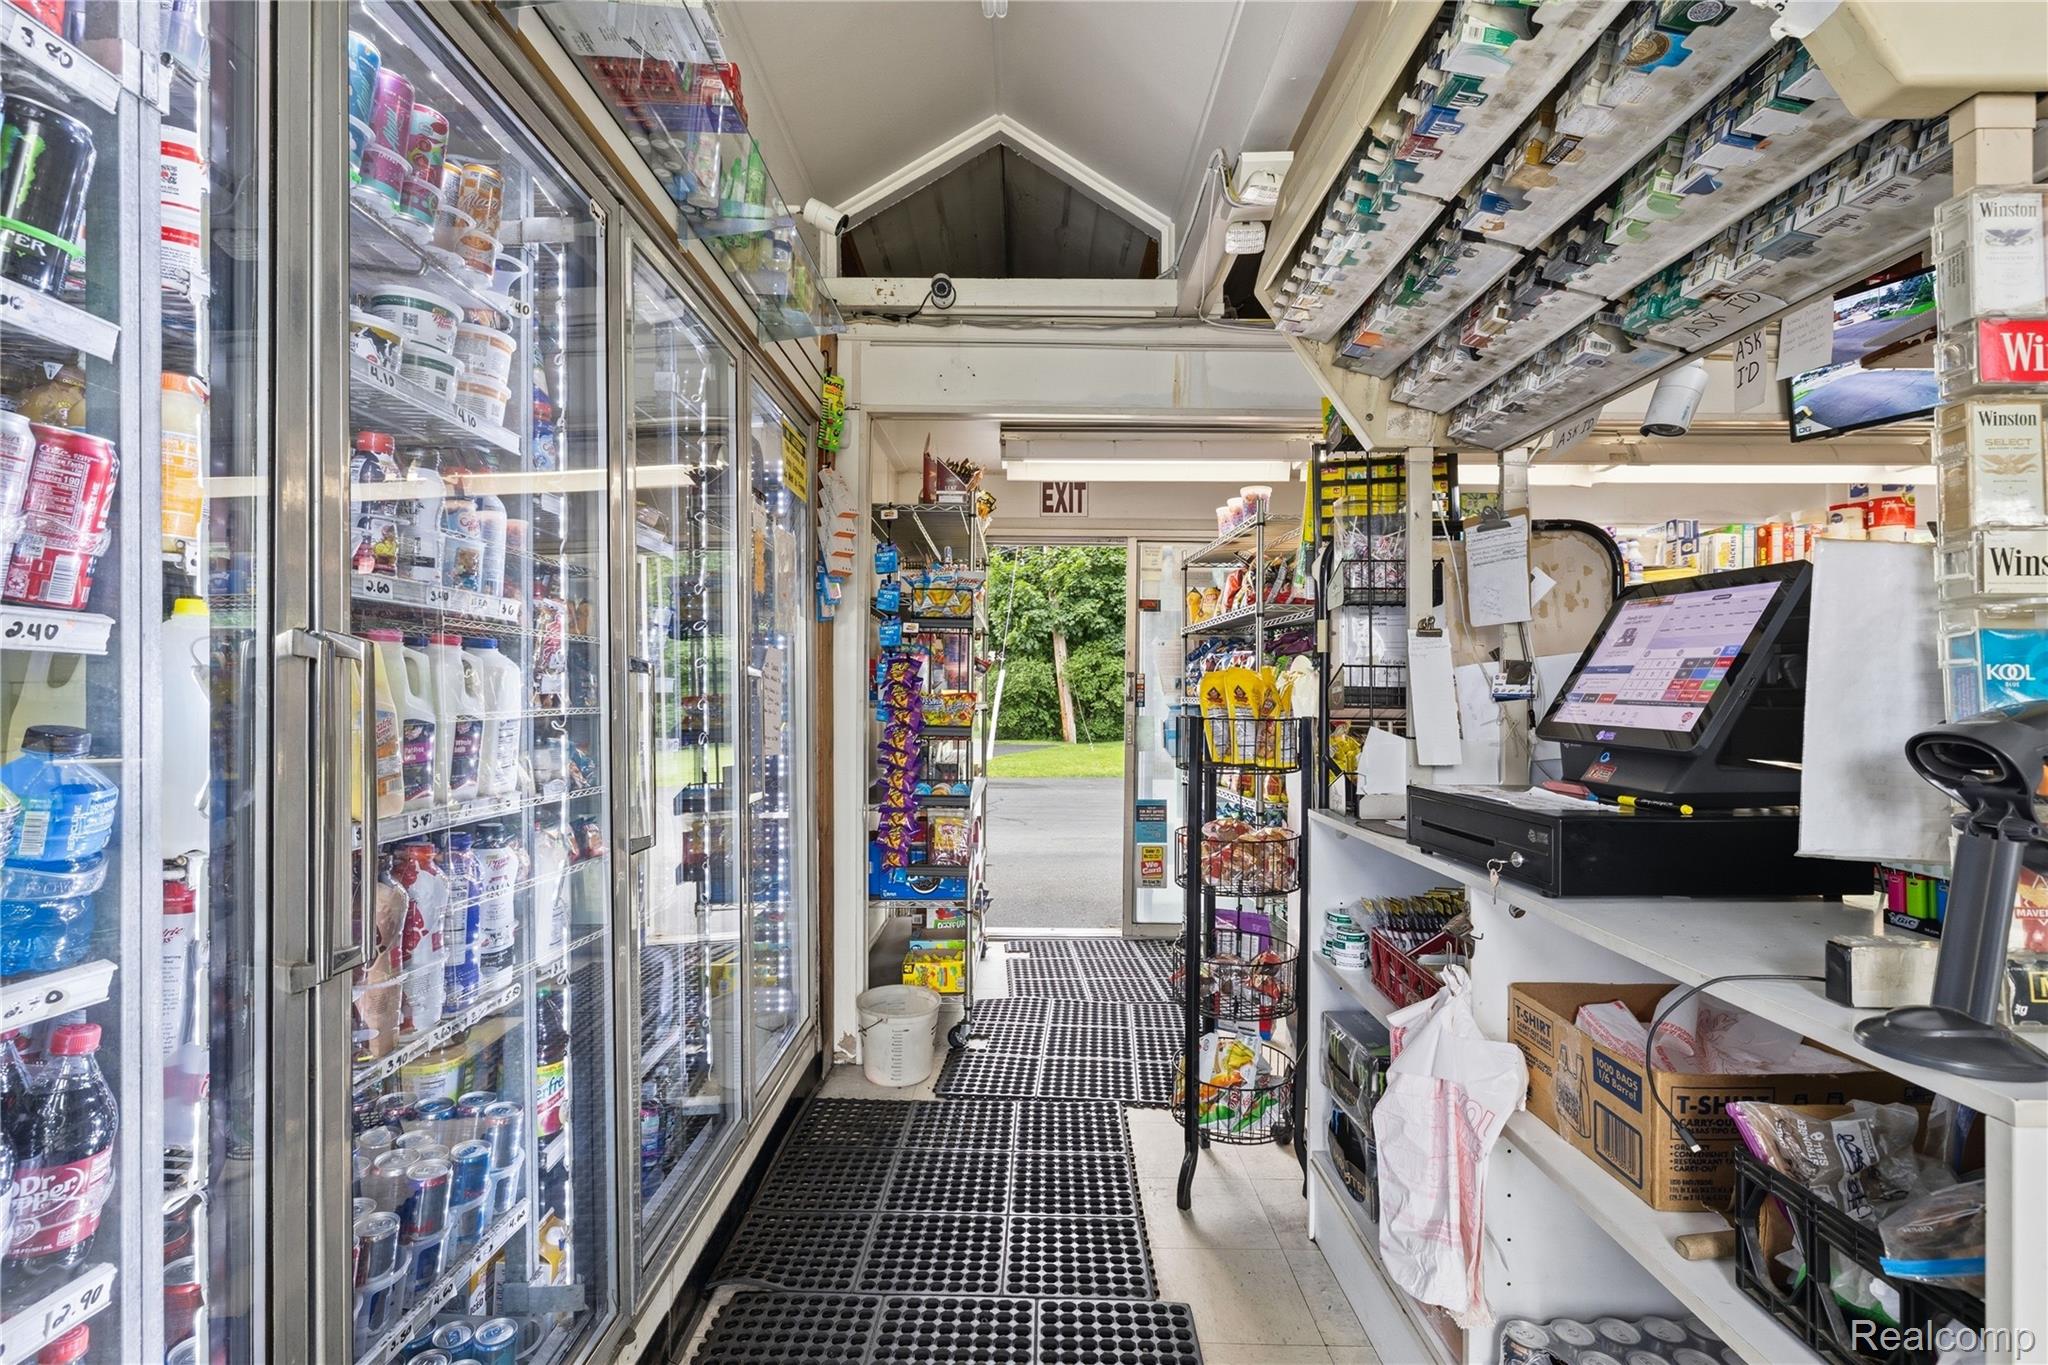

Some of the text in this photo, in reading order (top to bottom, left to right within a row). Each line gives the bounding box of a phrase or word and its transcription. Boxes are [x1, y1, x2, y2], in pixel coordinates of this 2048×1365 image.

[1980, 201, 2037, 218] Winston
[1684, 313, 1727, 338] ASK
[1736, 331, 1762, 361] ASK
[2000, 332, 2048, 372] Wi
[1978, 410, 2037, 427] Winston
[1556, 423, 1580, 448] ASK
[1984, 438, 2032, 446] SELECT
[1042, 482, 1086, 513] EXIT
[1988, 547, 2048, 577] Wins
[5, 620, 60, 641] 2.40
[1986, 663, 2036, 681] KOOL
[2016, 908, 2048, 917] MAVE
[1515, 1004, 1552, 1038] T-SHIRT
[1596, 1056, 1639, 1092] 1000 BAGS
[1597, 1069, 1637, 1101] 1/6 Barrel
[1680, 1118, 1736, 1129] CARRY-OU
[1813, 1142, 1829, 1167] SEAL
[20, 1175, 57, 1198] Dr
